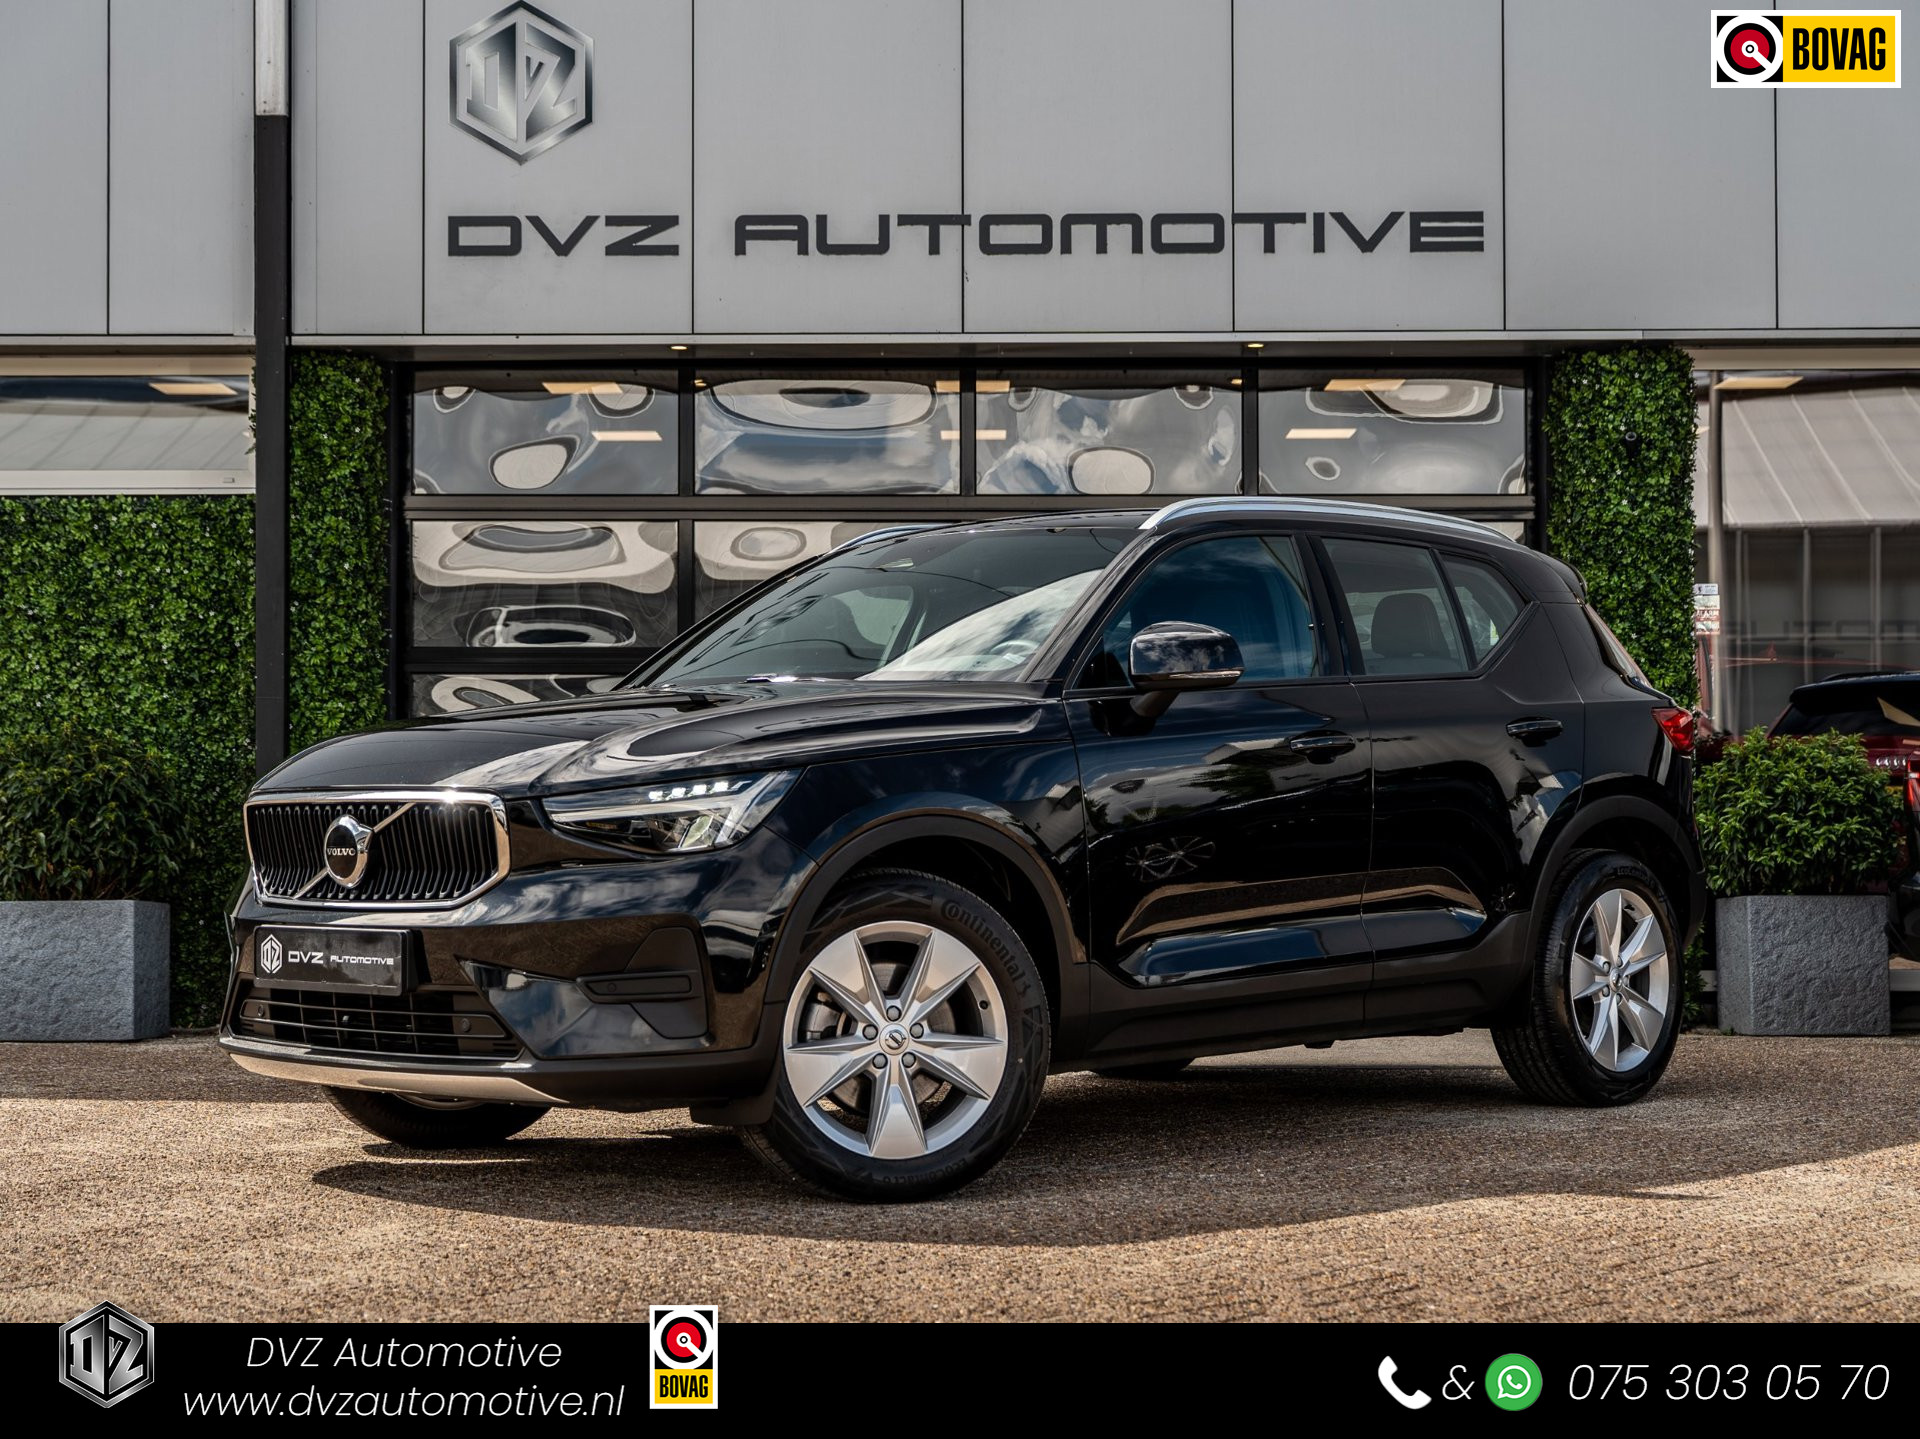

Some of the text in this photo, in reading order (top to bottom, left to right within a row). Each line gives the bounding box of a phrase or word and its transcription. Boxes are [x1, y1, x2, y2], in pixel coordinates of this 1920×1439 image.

[447, 211, 1485, 257] DVZ AUTOMOTIVE
[327, 847, 356, 856] VOLVO
[940, 898, 1026, 982] Continental
[288, 950, 394, 966] DVZ AUTOMOTIVE
